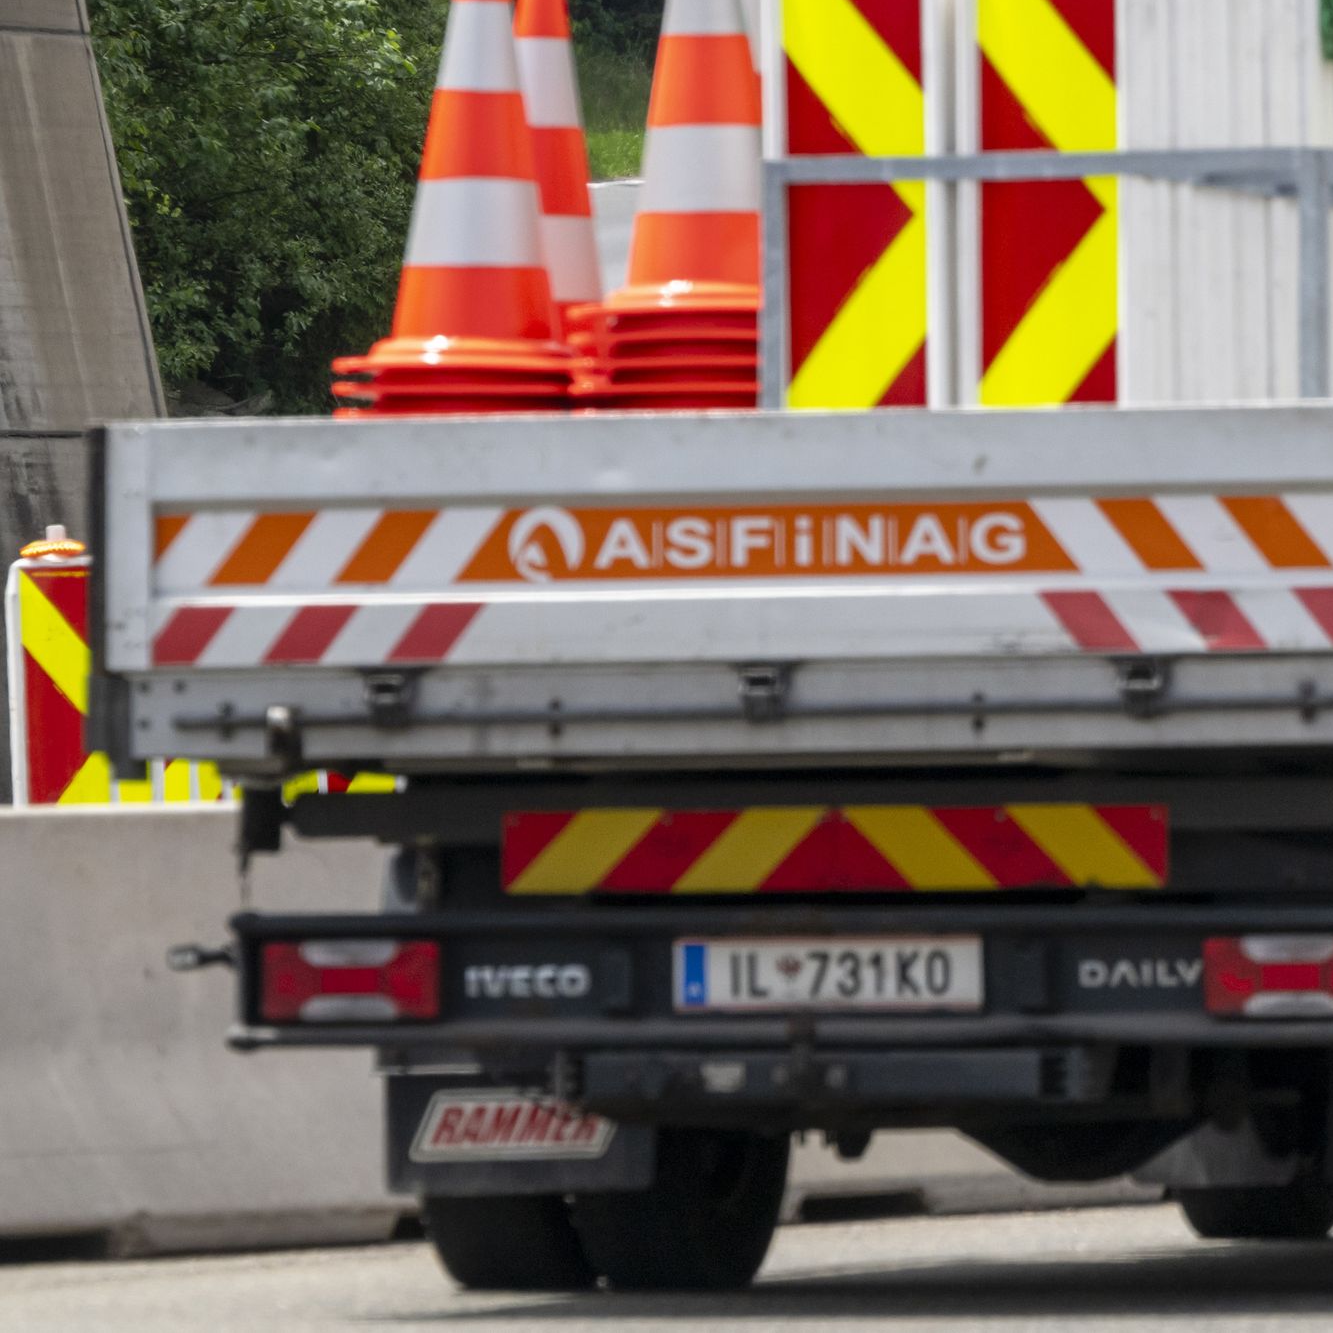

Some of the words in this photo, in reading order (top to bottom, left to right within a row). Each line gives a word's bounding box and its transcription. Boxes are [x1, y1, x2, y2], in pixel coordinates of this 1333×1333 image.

[464, 964, 592, 999] IVECO
[728, 951, 769, 998] IL
[1078, 959, 1203, 988] DAILY
[430, 1104, 600, 1145] RAMMER
